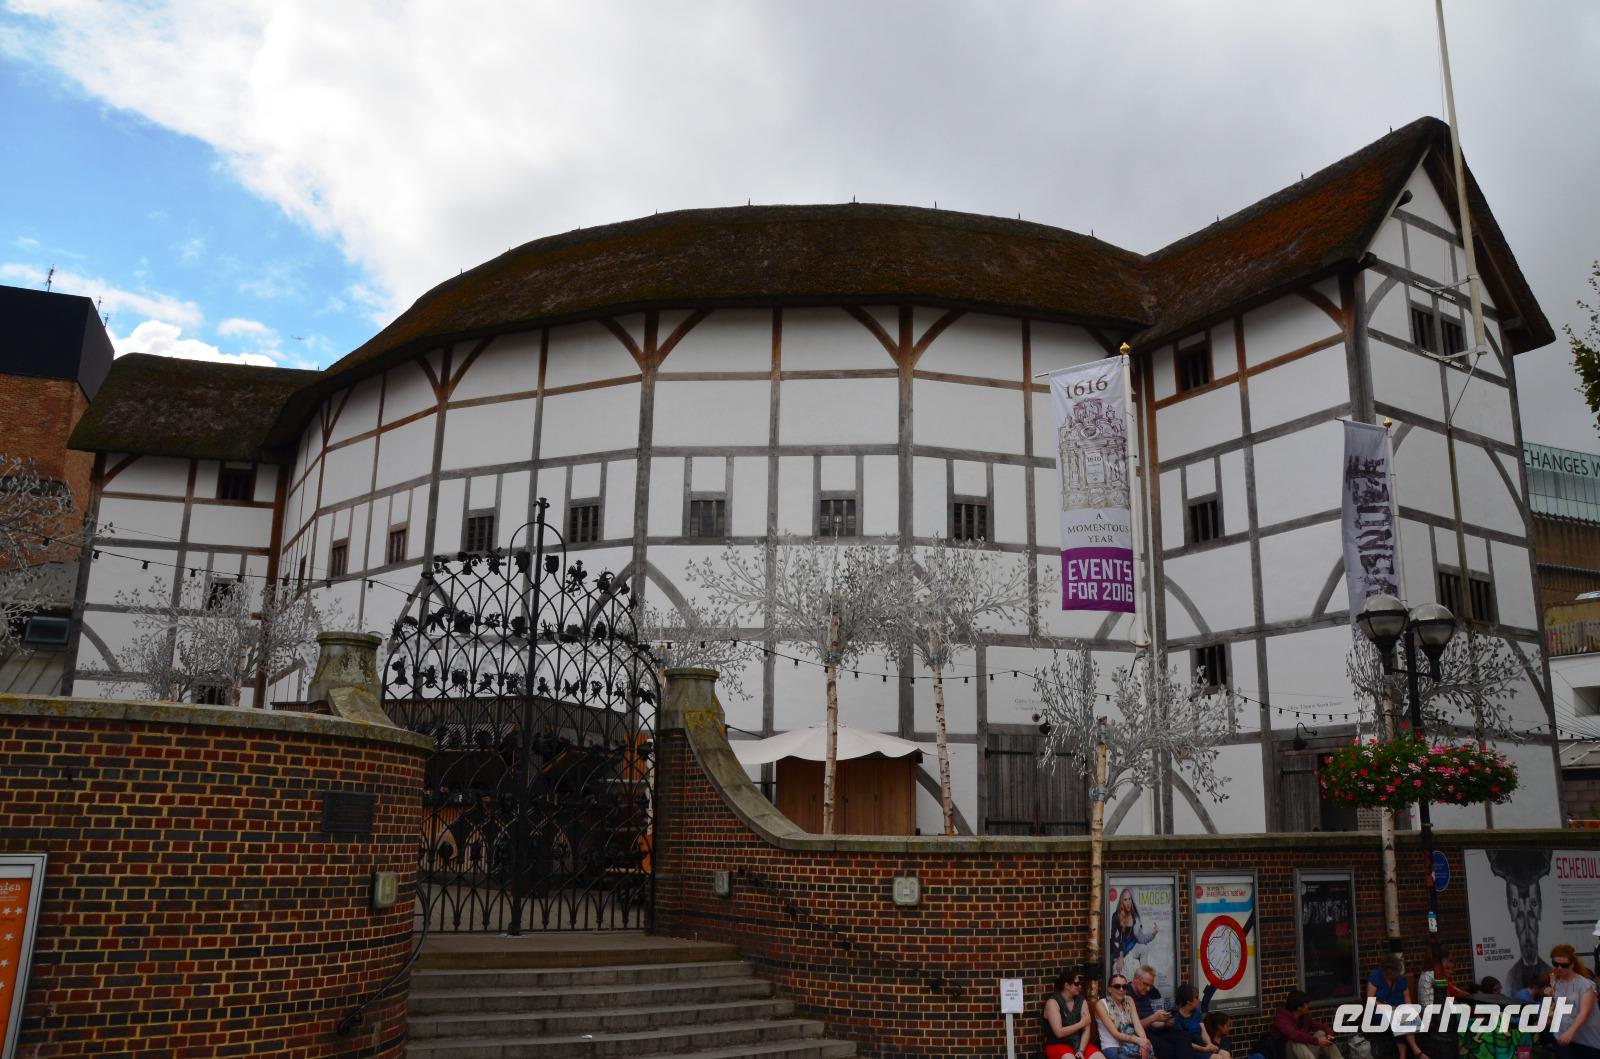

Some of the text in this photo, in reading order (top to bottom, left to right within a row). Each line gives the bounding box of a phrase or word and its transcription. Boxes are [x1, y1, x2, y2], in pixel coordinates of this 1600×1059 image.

[1064, 374, 1108, 399] 1616
[1067, 523, 1129, 534] MOMENTOUS
[1088, 535, 1114, 543] YEAR
[1068, 558, 1132, 582] EVENTS
[1068, 582, 1133, 603] FOR 2016
